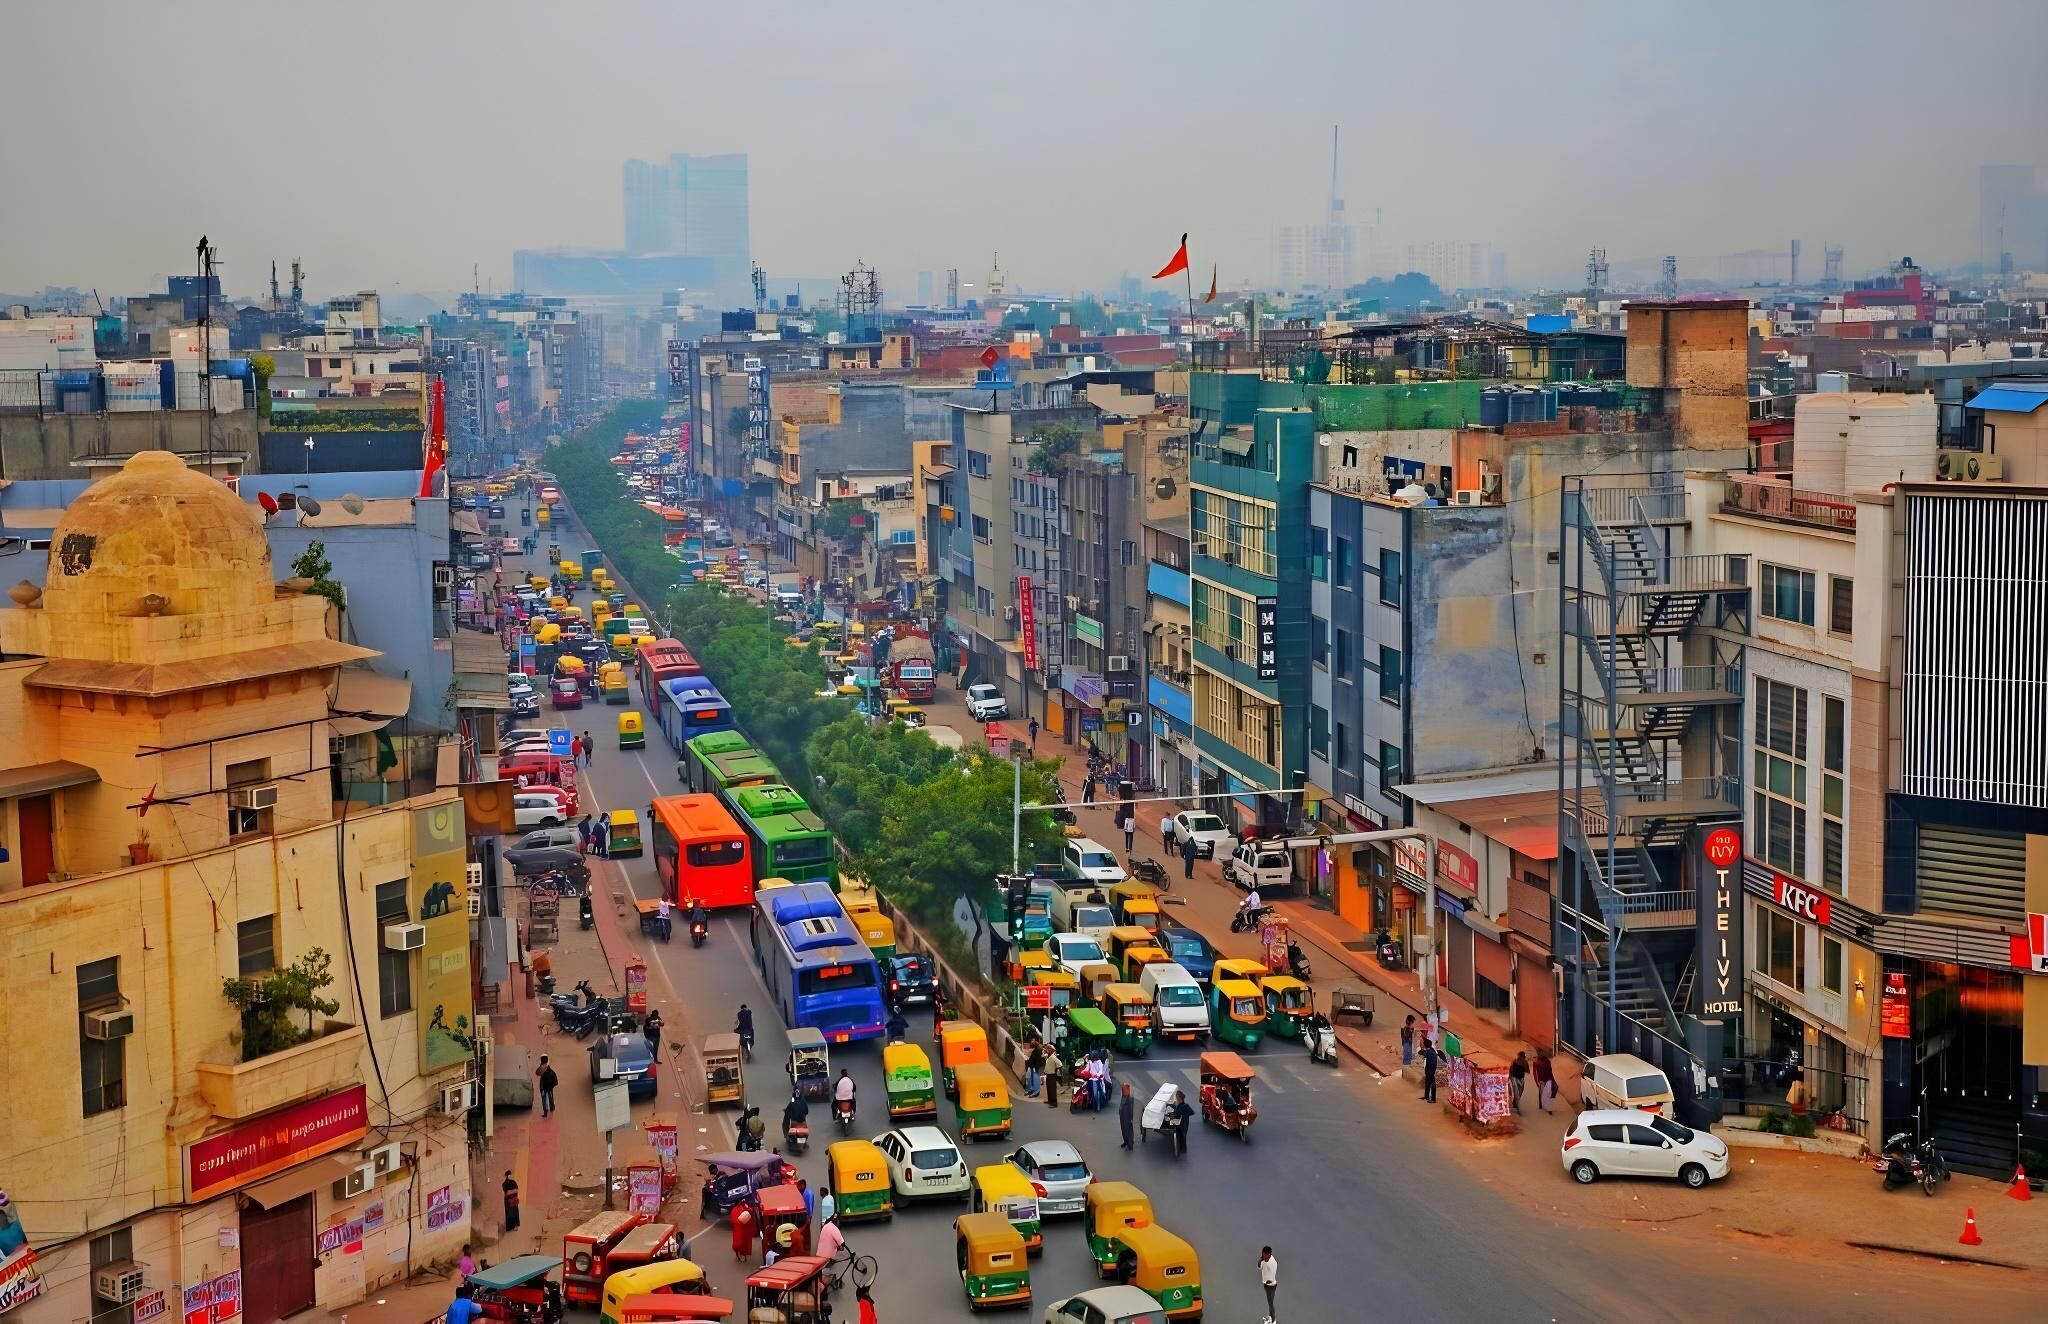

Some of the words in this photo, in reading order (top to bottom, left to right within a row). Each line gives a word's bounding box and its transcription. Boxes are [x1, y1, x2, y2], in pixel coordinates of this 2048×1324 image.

[1711, 845, 1735, 858] IVY
[1716, 869, 1730, 931] THE
[1780, 881, 1819, 920] KFC
[1717, 938, 1730, 996] IVY
